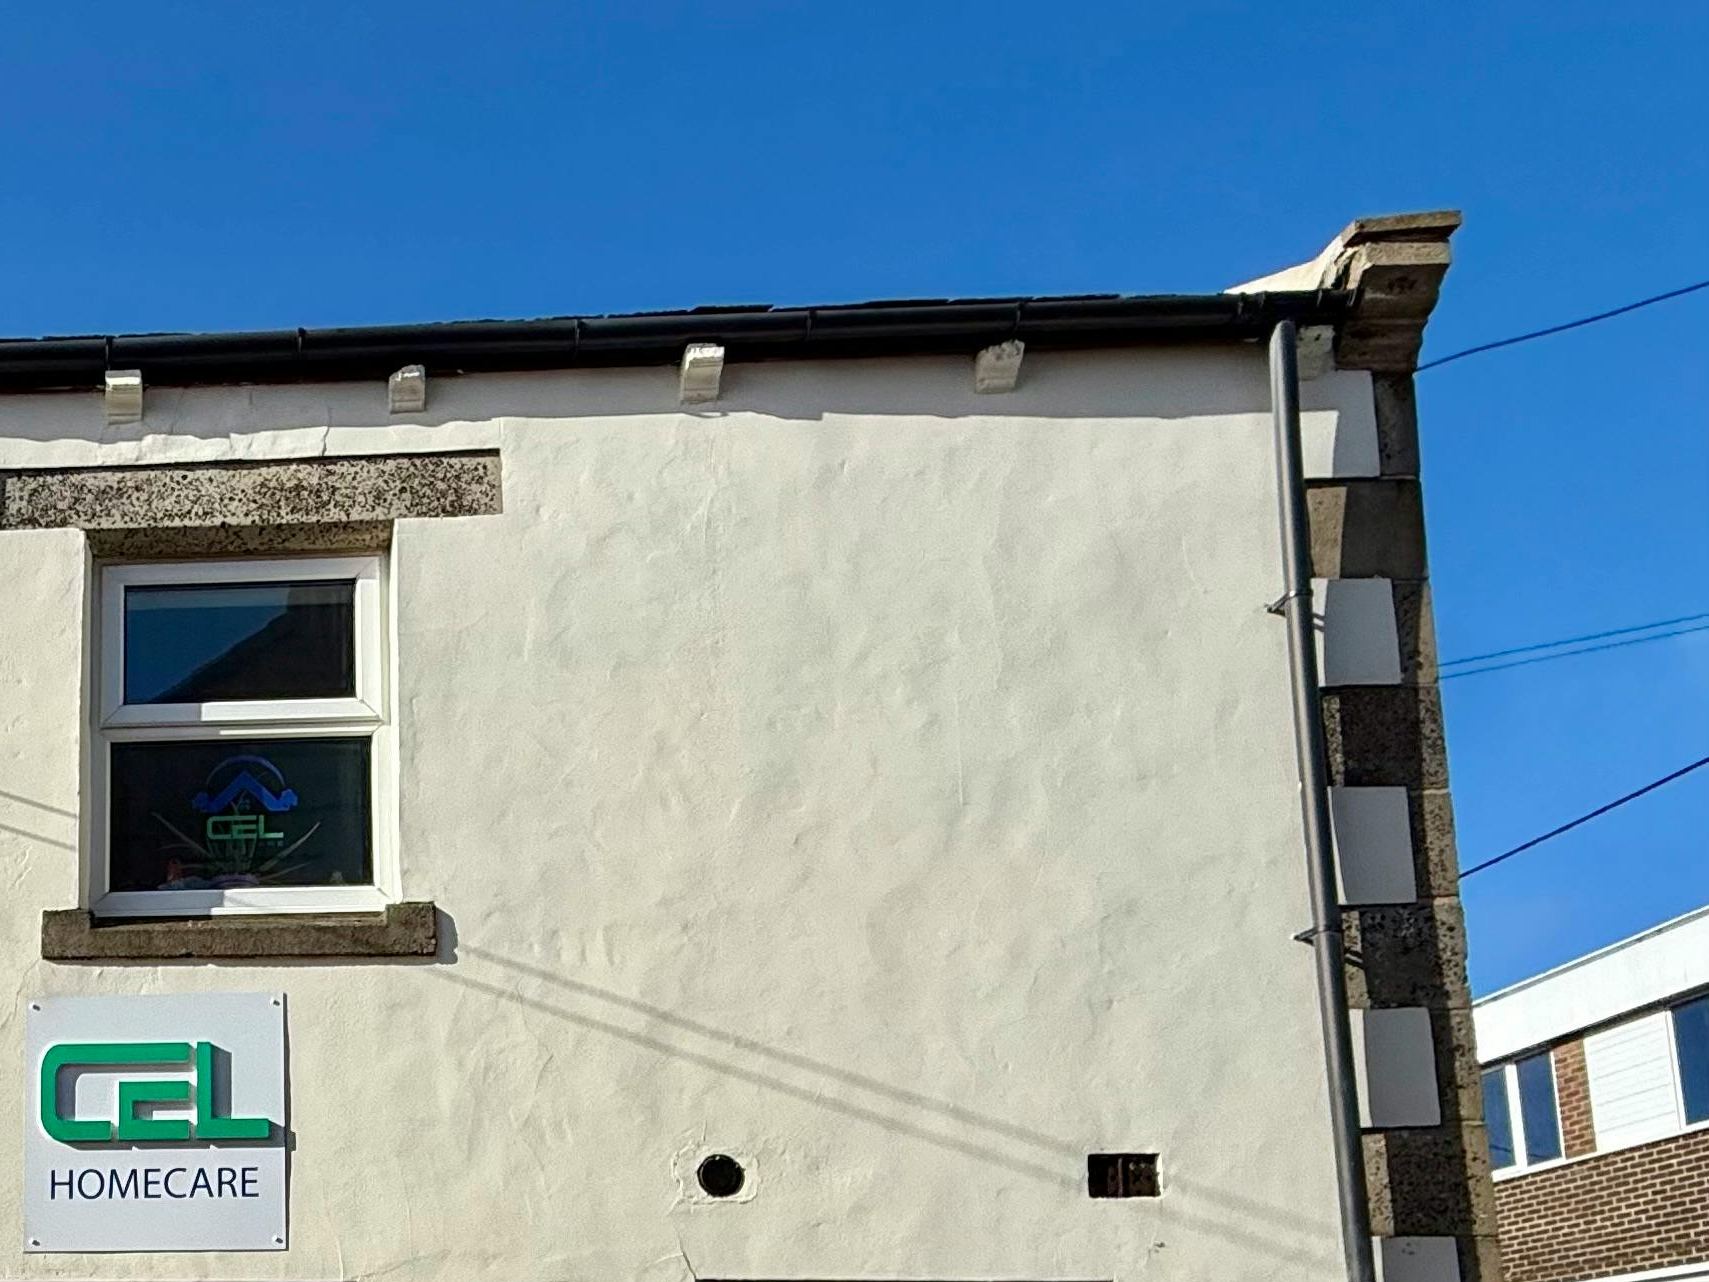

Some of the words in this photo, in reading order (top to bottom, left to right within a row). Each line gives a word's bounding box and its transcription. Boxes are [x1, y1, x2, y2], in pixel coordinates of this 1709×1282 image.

[206, 815, 284, 840] CEL
[40, 1041, 270, 1142] CEL
[50, 1167, 260, 1200] HOMECARE
